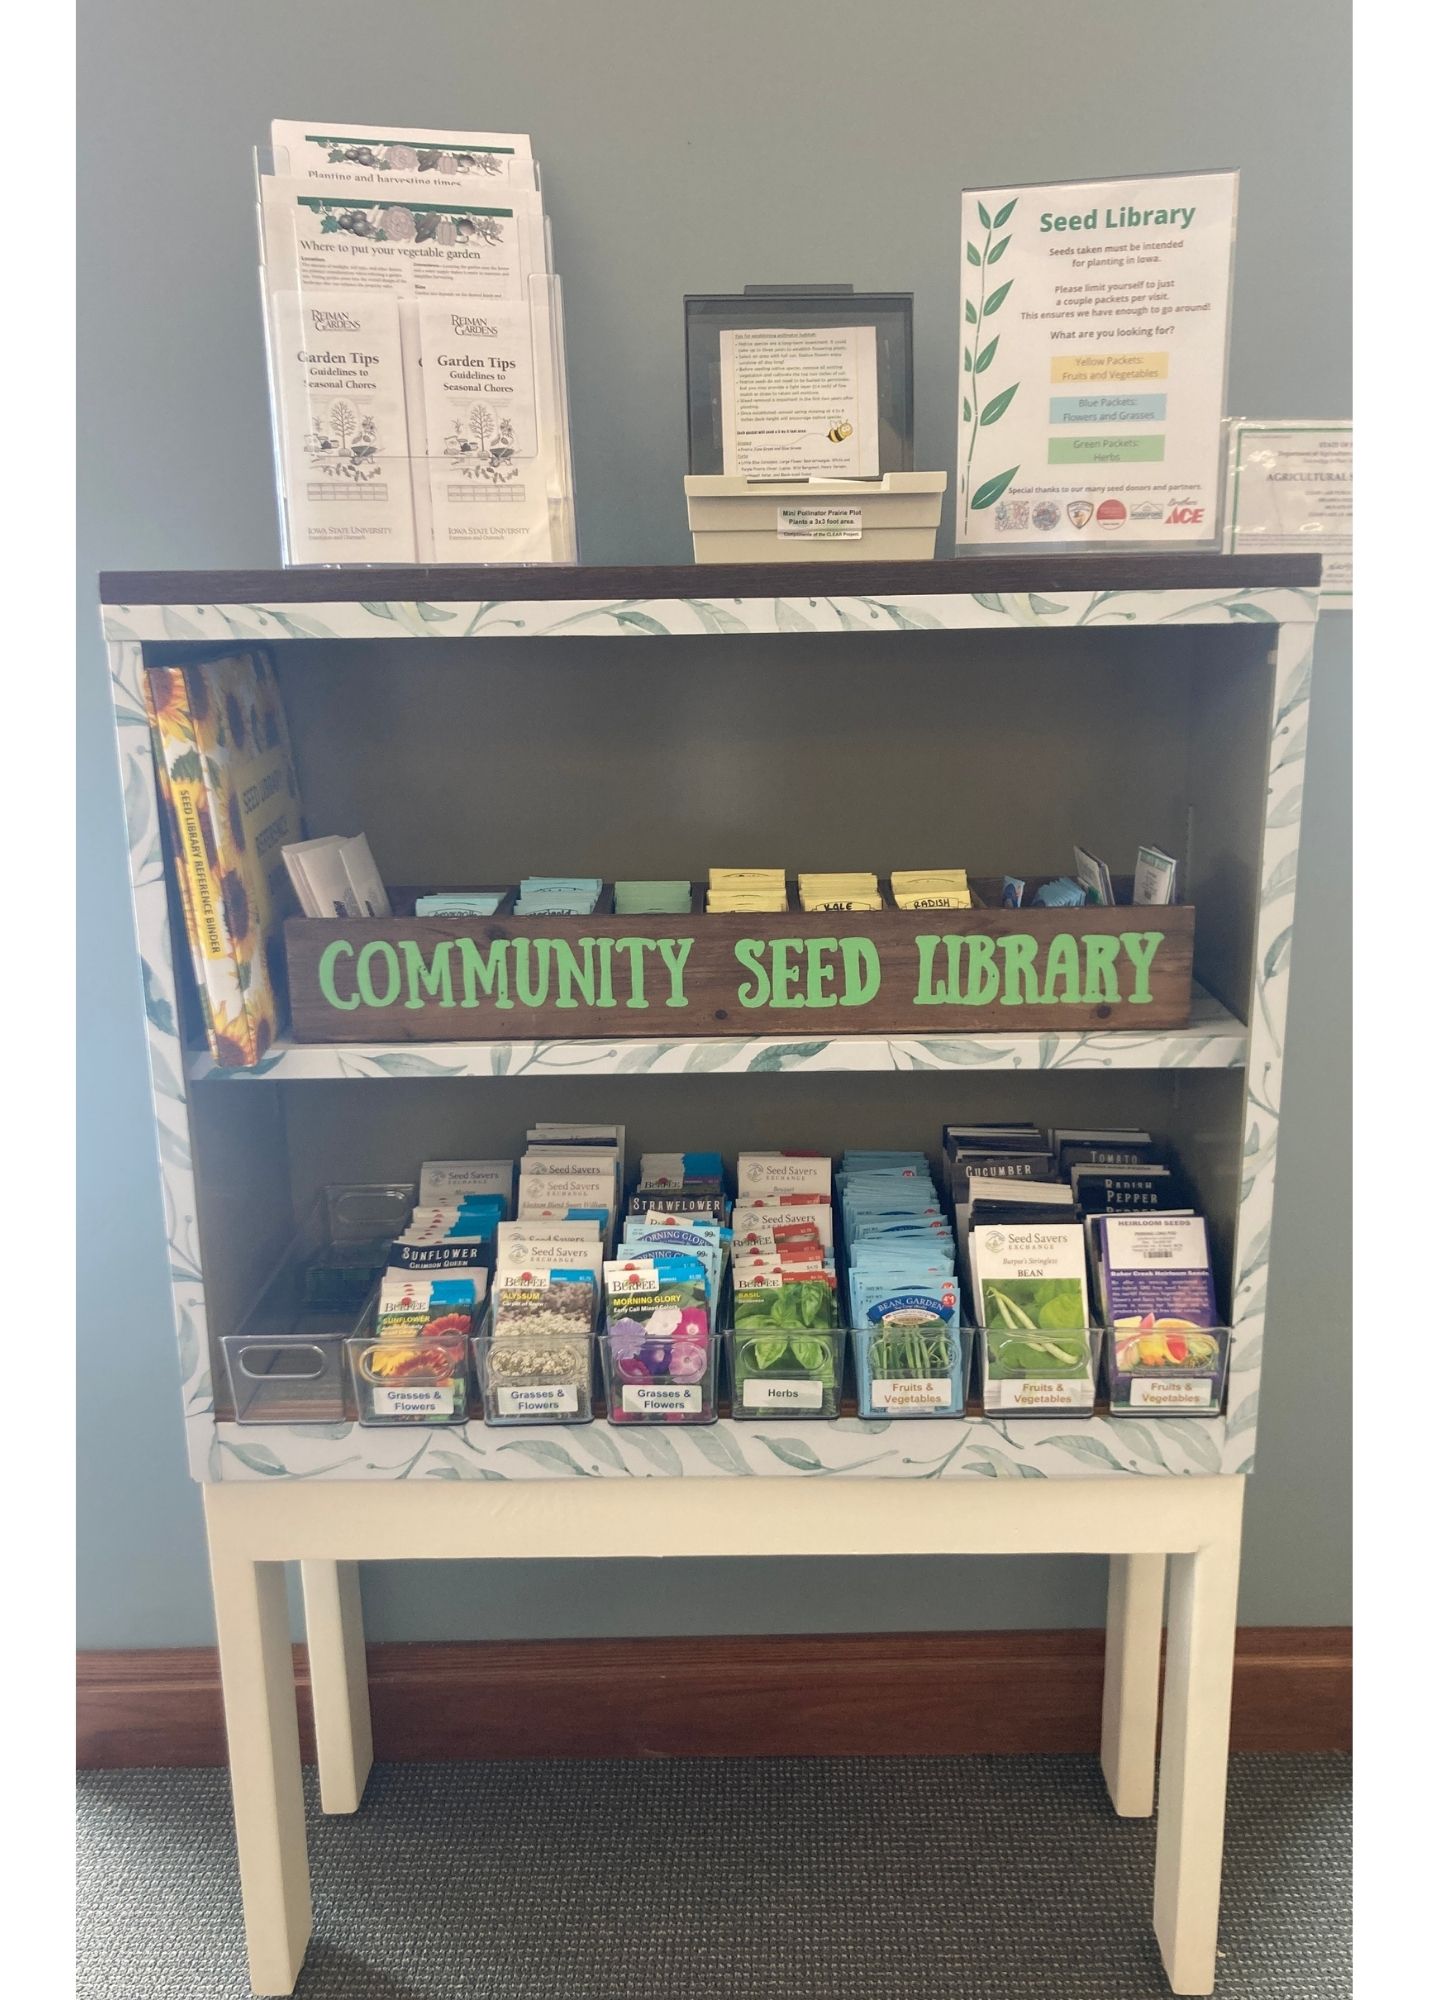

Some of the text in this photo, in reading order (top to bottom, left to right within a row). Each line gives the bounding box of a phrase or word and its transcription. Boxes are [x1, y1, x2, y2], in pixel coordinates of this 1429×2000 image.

[355, 174, 373, 182] and
[1040, 207, 1196, 232] Seed Library
[301, 240, 480, 260] Where to put your vegetable garden
[1050, 240, 1183, 256] Seeds taken must be intended
[1072, 255, 1161, 269] for planting in Iowa.
[1055, 280, 1175, 293] Please limit yourself to just
[1064, 296, 1093, 306] couple
[1095, 294, 1128, 306] packets
[1132, 294, 1146, 304] per
[1149, 293, 1168, 301] visit.
[1021, 312, 1038, 320] This
[1041, 311, 1074, 319] ensures
[1092, 308, 1112, 316] have
[1115, 306, 1148, 317] enough
[1162, 306, 1172, 315] go
[1175, 303, 1211, 313] around!
[315, 321, 360, 331] GARDENS
[455, 326, 498, 335] GARDENS
[1050, 326, 1175, 339] What are you looking for?
[297, 351, 379, 367] Garden Tips
[437, 355, 516, 371] Garden Tips
[1076, 356, 1144, 366] Yellow Packets:
[310, 368, 357, 376] Guidelines
[450, 371, 494, 380] Guidelines
[1062, 370, 1158, 380] Fruits and Vegetables
[346, 380, 376, 389] Chores
[444, 383, 513, 392] Seasonal Chores
[1079, 398, 1137, 407] Blue Packets:
[1064, 411, 1154, 422] Flowers and Grasses
[1073, 439, 1139, 449] Green Packets:
[1094, 453, 1120, 462] Herbs
[1266, 473, 1346, 482] AGRICULTURAL
[1085, 486, 1104, 494] many
[1165, 506, 1205, 524] ACE
[180, 790, 220, 953] SEED LIBRARY REFERENCE BINDER
[914, 899, 950, 908] RADISH
[319, 932, 1165, 1010] COMMUNITY SEED LIBRARY
[1091, 1151, 1137, 1164] TOMATO
[549, 1165, 600, 1174] Seed Savers
[767, 1166, 817, 1175] Seed Savers
[966, 1165, 1031, 1178] CUCUMBER
[548, 1181, 599, 1191] Seed Savers
[1107, 1190, 1158, 1204] PEPPER
[634, 1197, 720, 1210] STRAWFLOWER
[762, 1214, 815, 1224] Seed Savers
[1008, 1233, 1067, 1243] Seed Savers
[402, 1247, 478, 1261] SUNFLOWER
[532, 1247, 588, 1257] Seed Savers
[613, 1280, 656, 1291] BURPEE
[739, 1280, 779, 1288] BURPEE
[502, 1292, 541, 1300] ALYSSUM
[614, 1295, 681, 1306] MORNING GLORY
[907, 1298, 944, 1310] GARDEN
[383, 1315, 430, 1324] SUNFLOWER
[892, 1383, 933, 1392] Fruits &
[1023, 1384, 1053, 1392] Fruits
[1151, 1383, 1192, 1391] Fruits &
[388, 1391, 441, 1400] Grasses &
[511, 1389, 565, 1399] Grasses &
[638, 1389, 691, 1398] Grasses &
[768, 1389, 799, 1398] Herbs
[1142, 1394, 1200, 1403] Vegetables
[644, 1400, 685, 1408] Flowers
[885, 1394, 941, 1404] Vegetables
[1014, 1395, 1072, 1404] Vegetables
[395, 1403, 436, 1411] Flowers
[518, 1401, 559, 1409] Flowers
